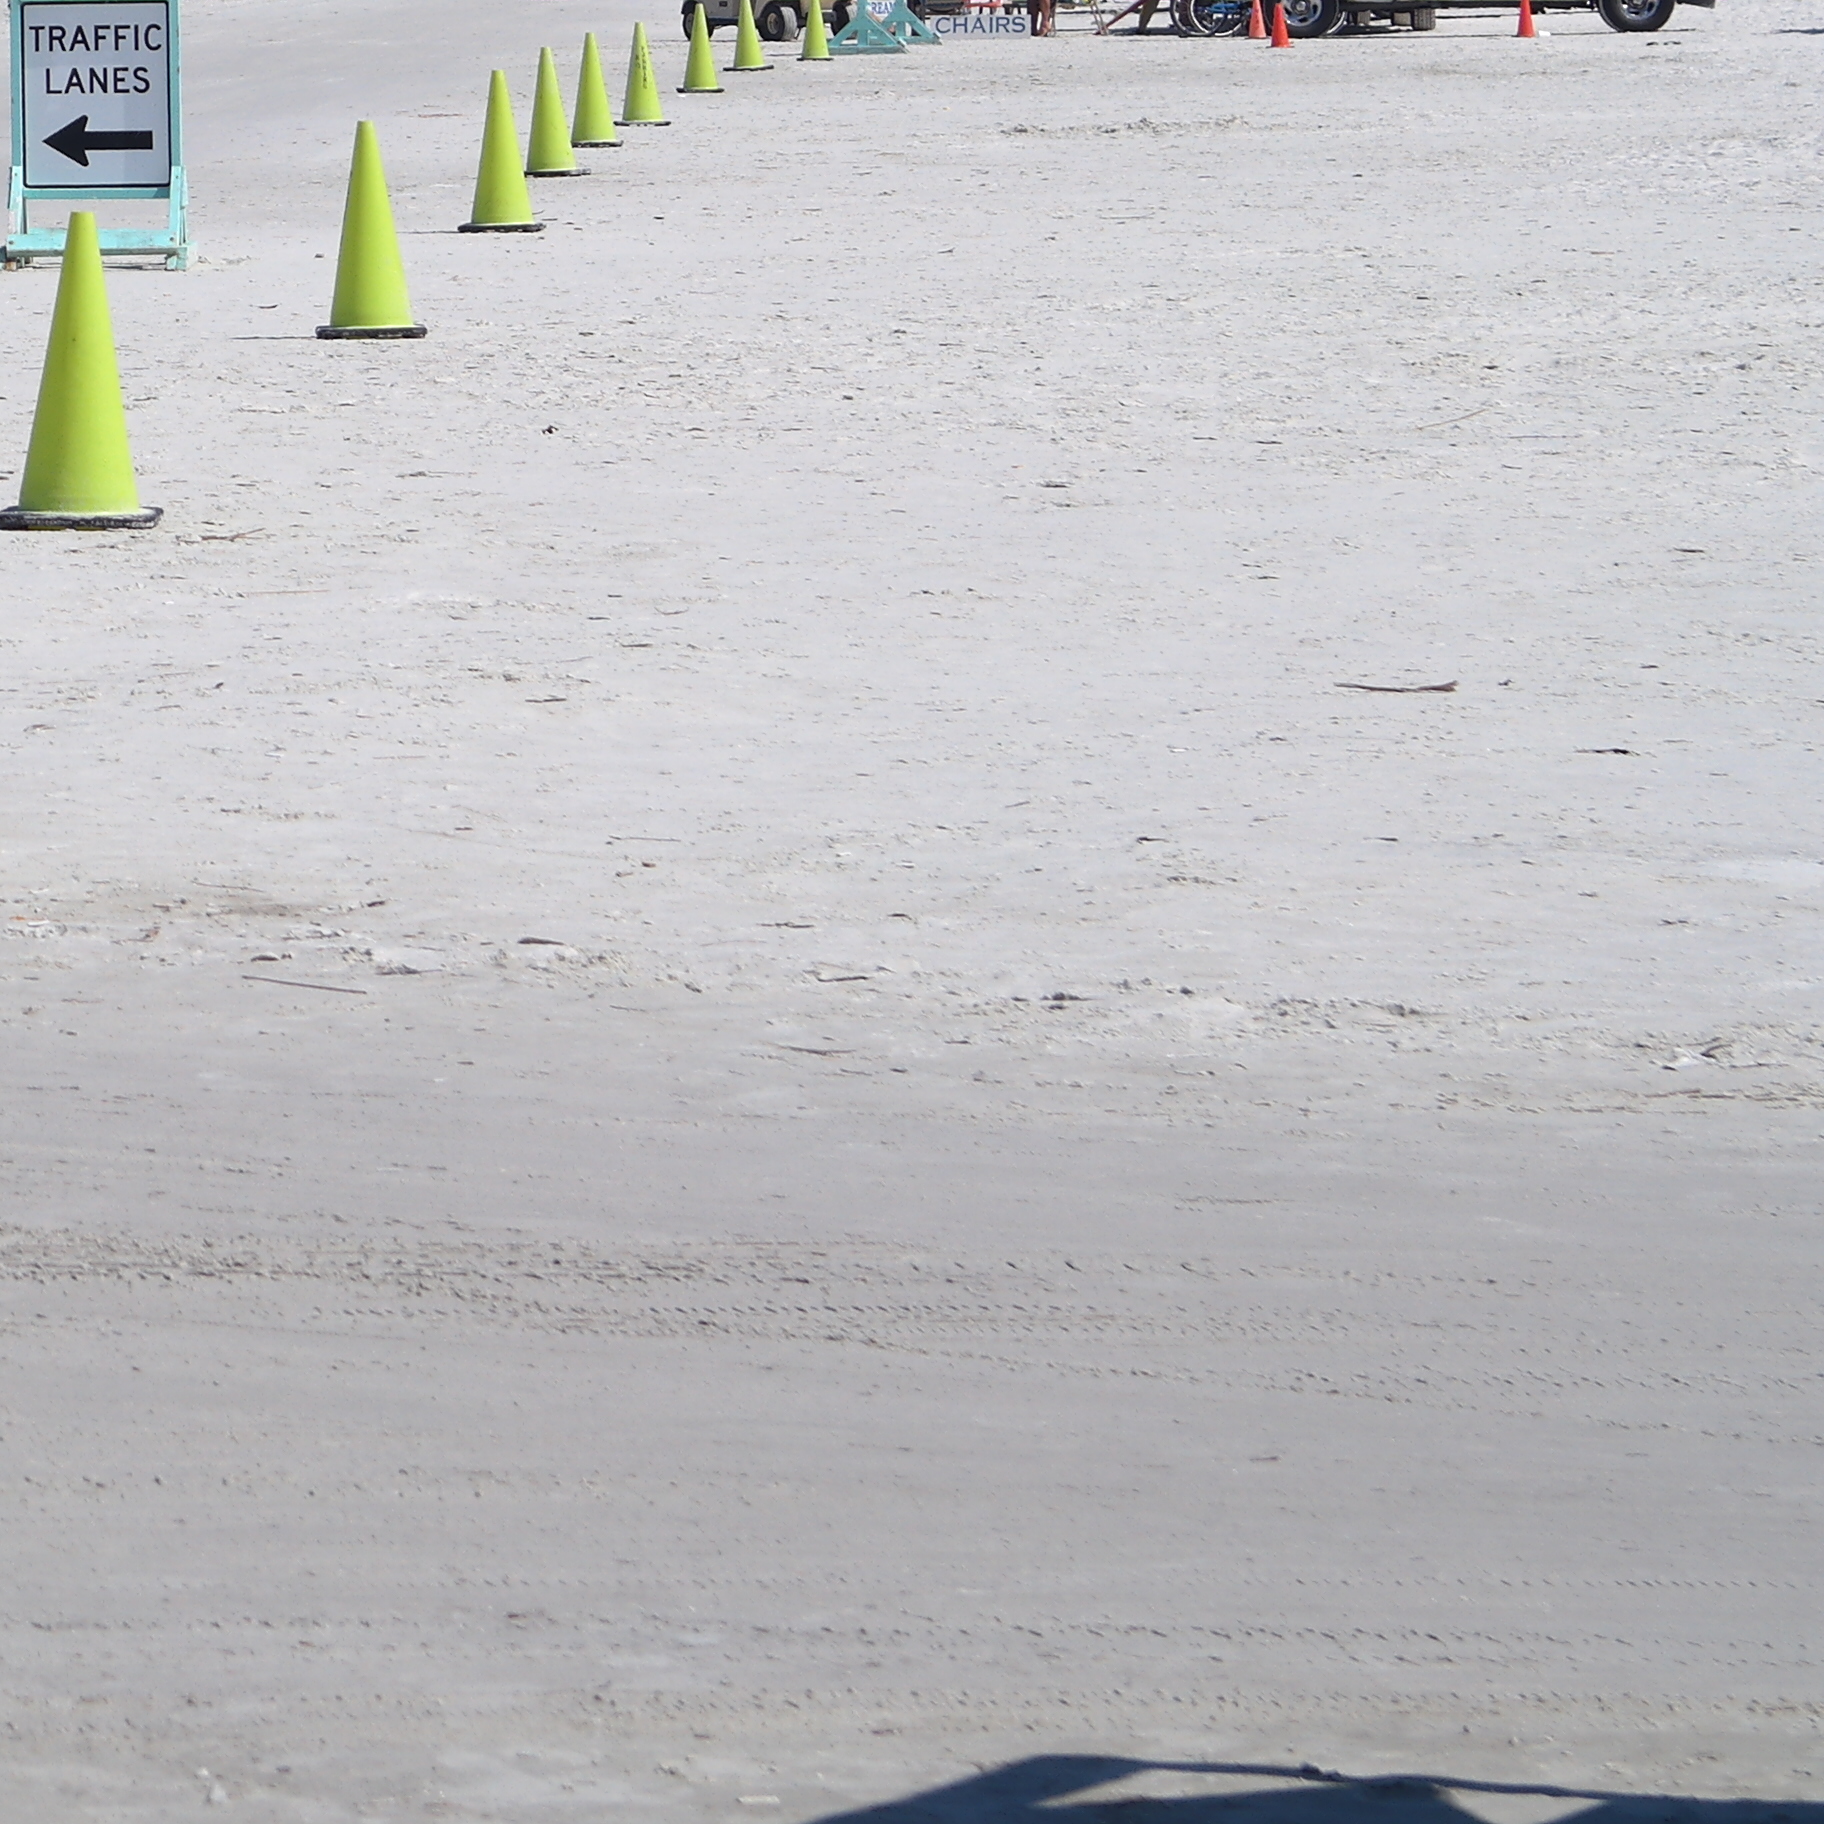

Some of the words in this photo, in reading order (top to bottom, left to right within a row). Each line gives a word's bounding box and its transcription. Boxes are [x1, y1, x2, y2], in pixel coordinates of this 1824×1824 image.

[28, 23, 162, 52] TRAFFIC
[935, 17, 1026, 34] CHAIRS
[45, 66, 150, 94] LANES
